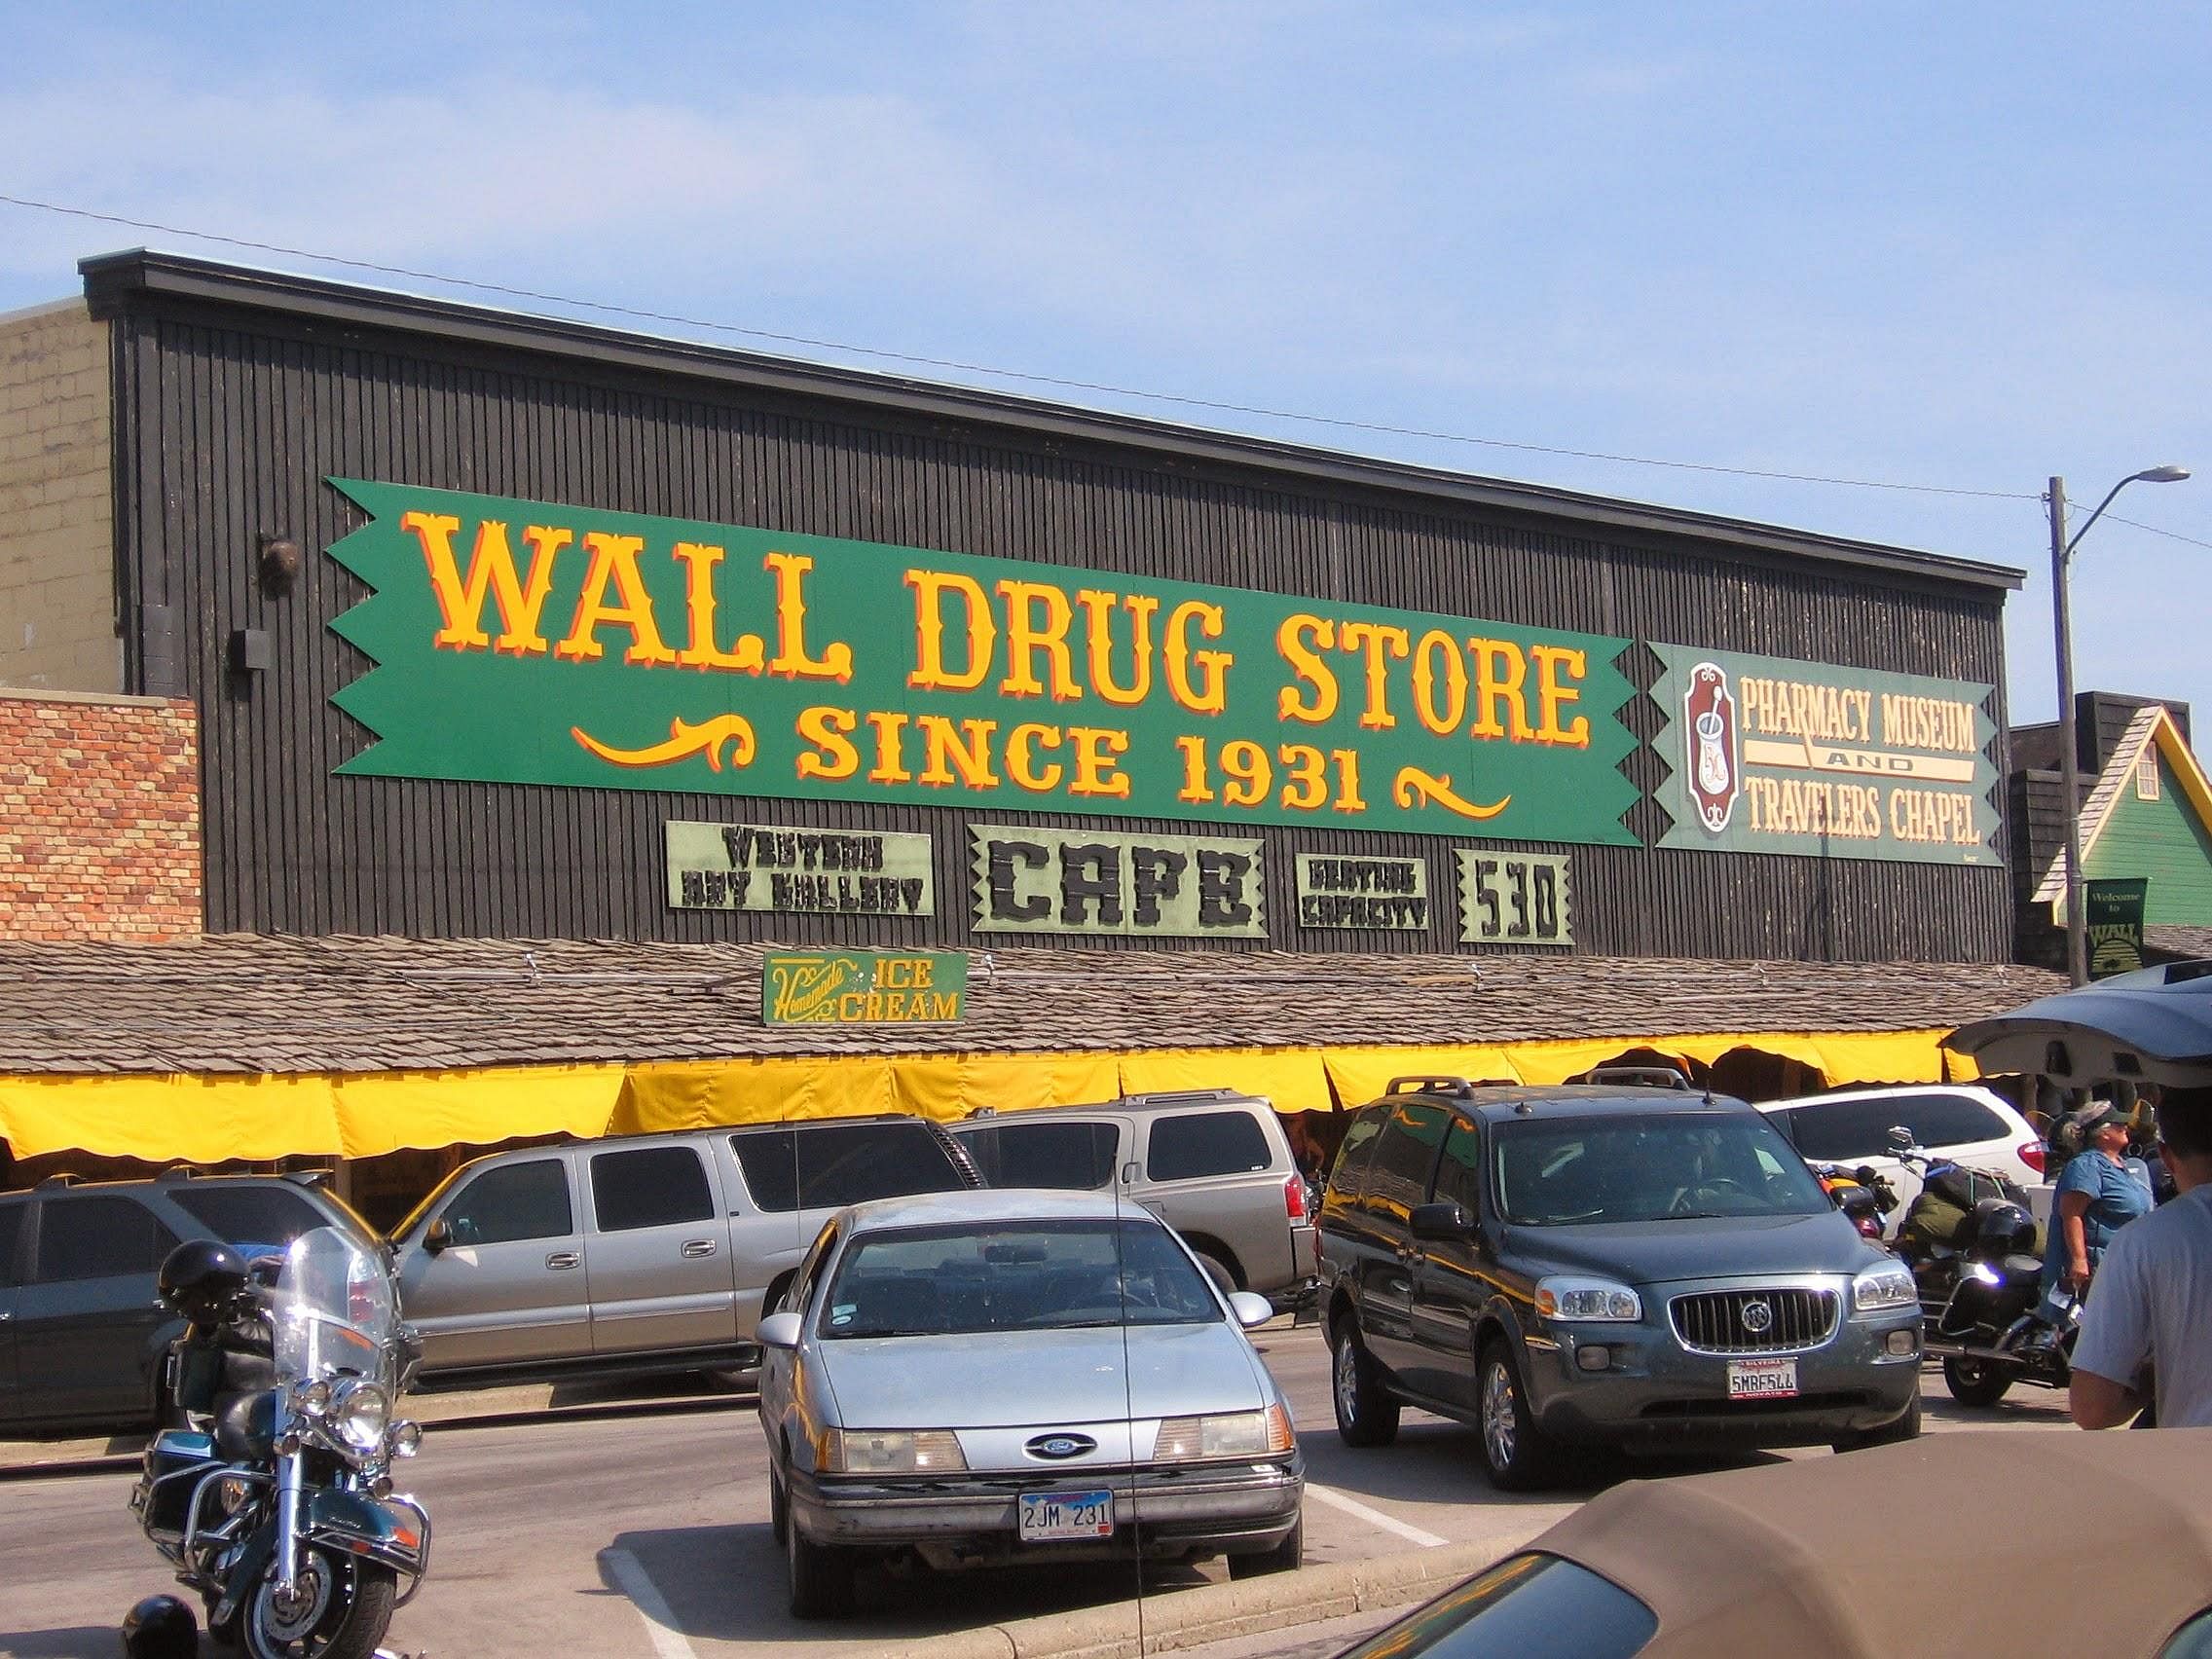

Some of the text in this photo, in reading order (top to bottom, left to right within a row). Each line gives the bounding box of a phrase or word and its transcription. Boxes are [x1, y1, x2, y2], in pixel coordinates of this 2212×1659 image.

[401, 510, 1591, 750] WALL DRUG STORE
[1740, 677, 1976, 754] PHARMACY MUSEUM
[795, 705, 1367, 814] SINCE 1931
[1825, 752, 1914, 772] AND
[1744, 776, 1980, 846] TRAVELERS CHAPEL
[721, 827, 884, 871] WESTERN
[771, 872, 924, 913] GALLERY
[986, 839, 1253, 928] CAFE
[1308, 859, 1417, 895] SEATING
[1301, 894, 1427, 928] CAPACITY
[1474, 859, 1560, 940] 530
[2092, 892, 2141, 903] Welcome
[2109, 903, 2120, 912] to
[874, 958, 934, 990] ICE
[838, 991, 959, 1022] CREAM
[1023, 1502, 1110, 1529] 2JM 231
